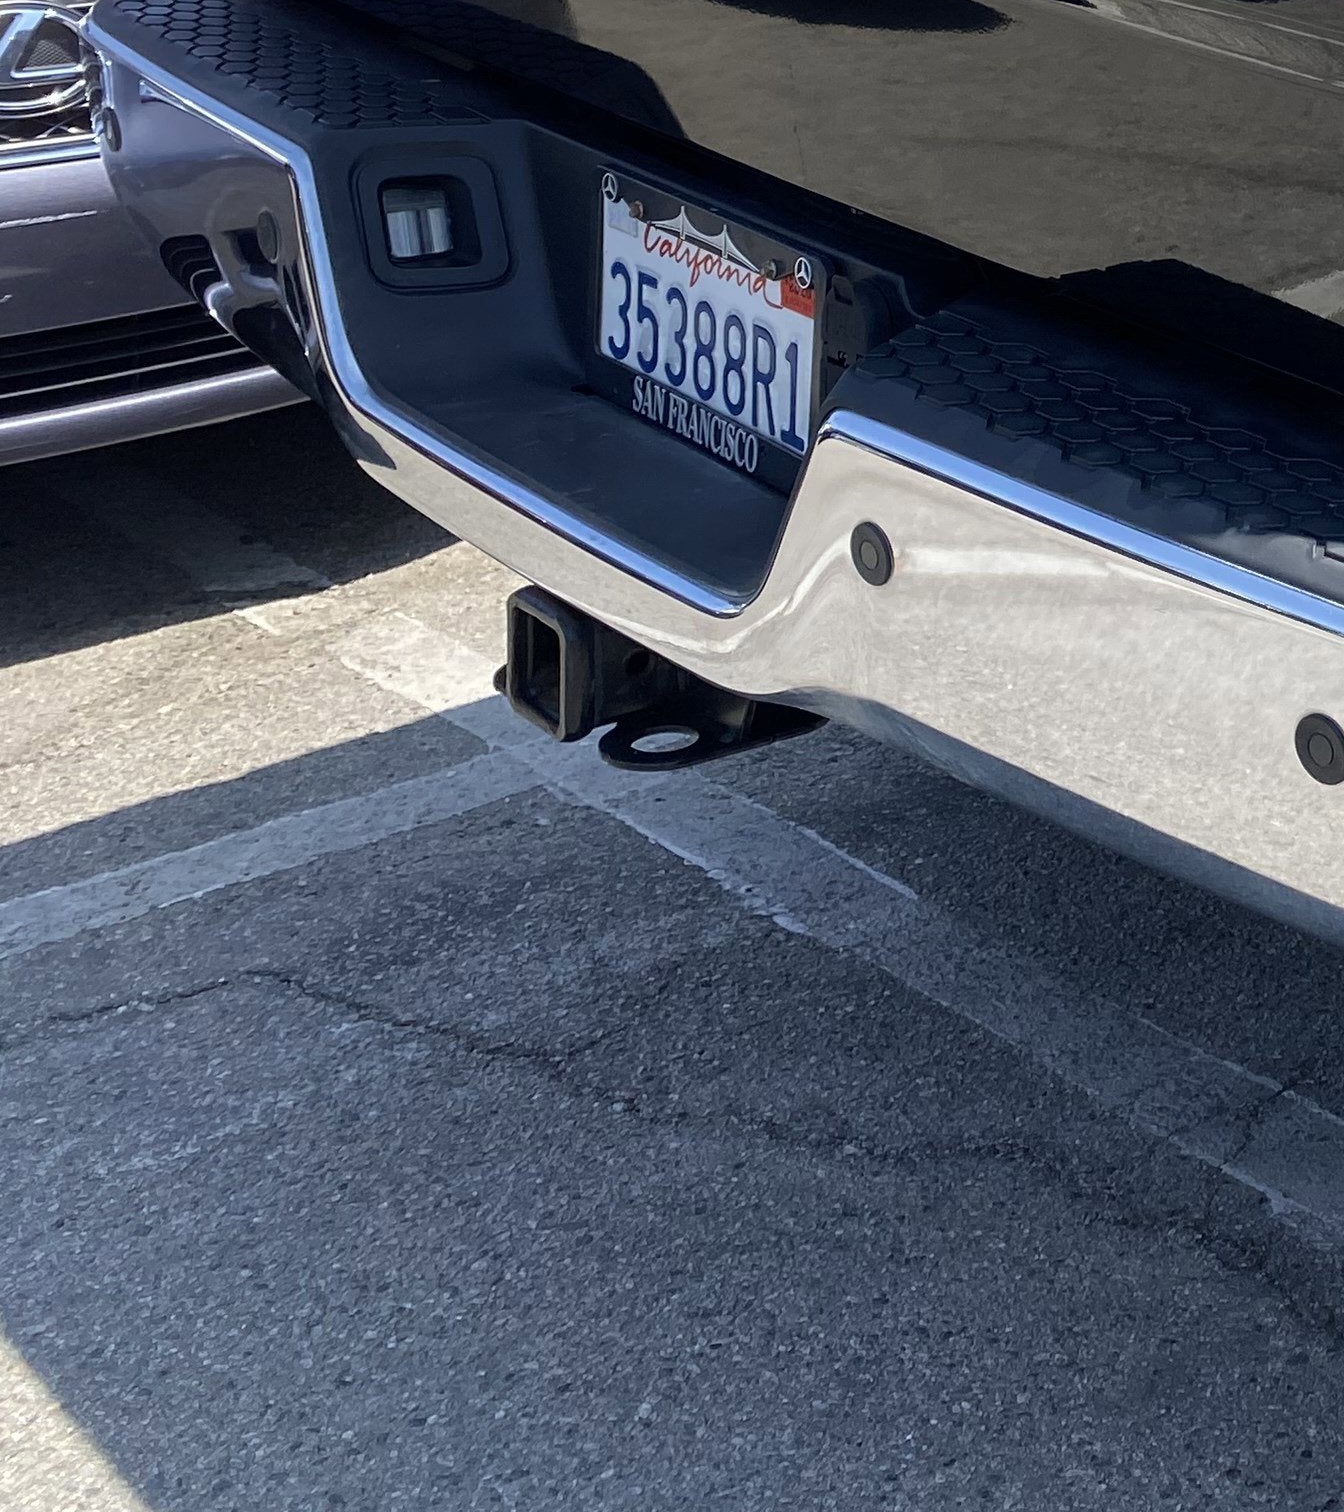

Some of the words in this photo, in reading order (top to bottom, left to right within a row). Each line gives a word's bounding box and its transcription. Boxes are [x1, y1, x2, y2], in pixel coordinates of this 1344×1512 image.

[643, 222, 784, 309] California
[608, 261, 805, 454] 35388R1
[632, 375, 666, 425] SAN
[668, 386, 758, 473] FRANCISCO
